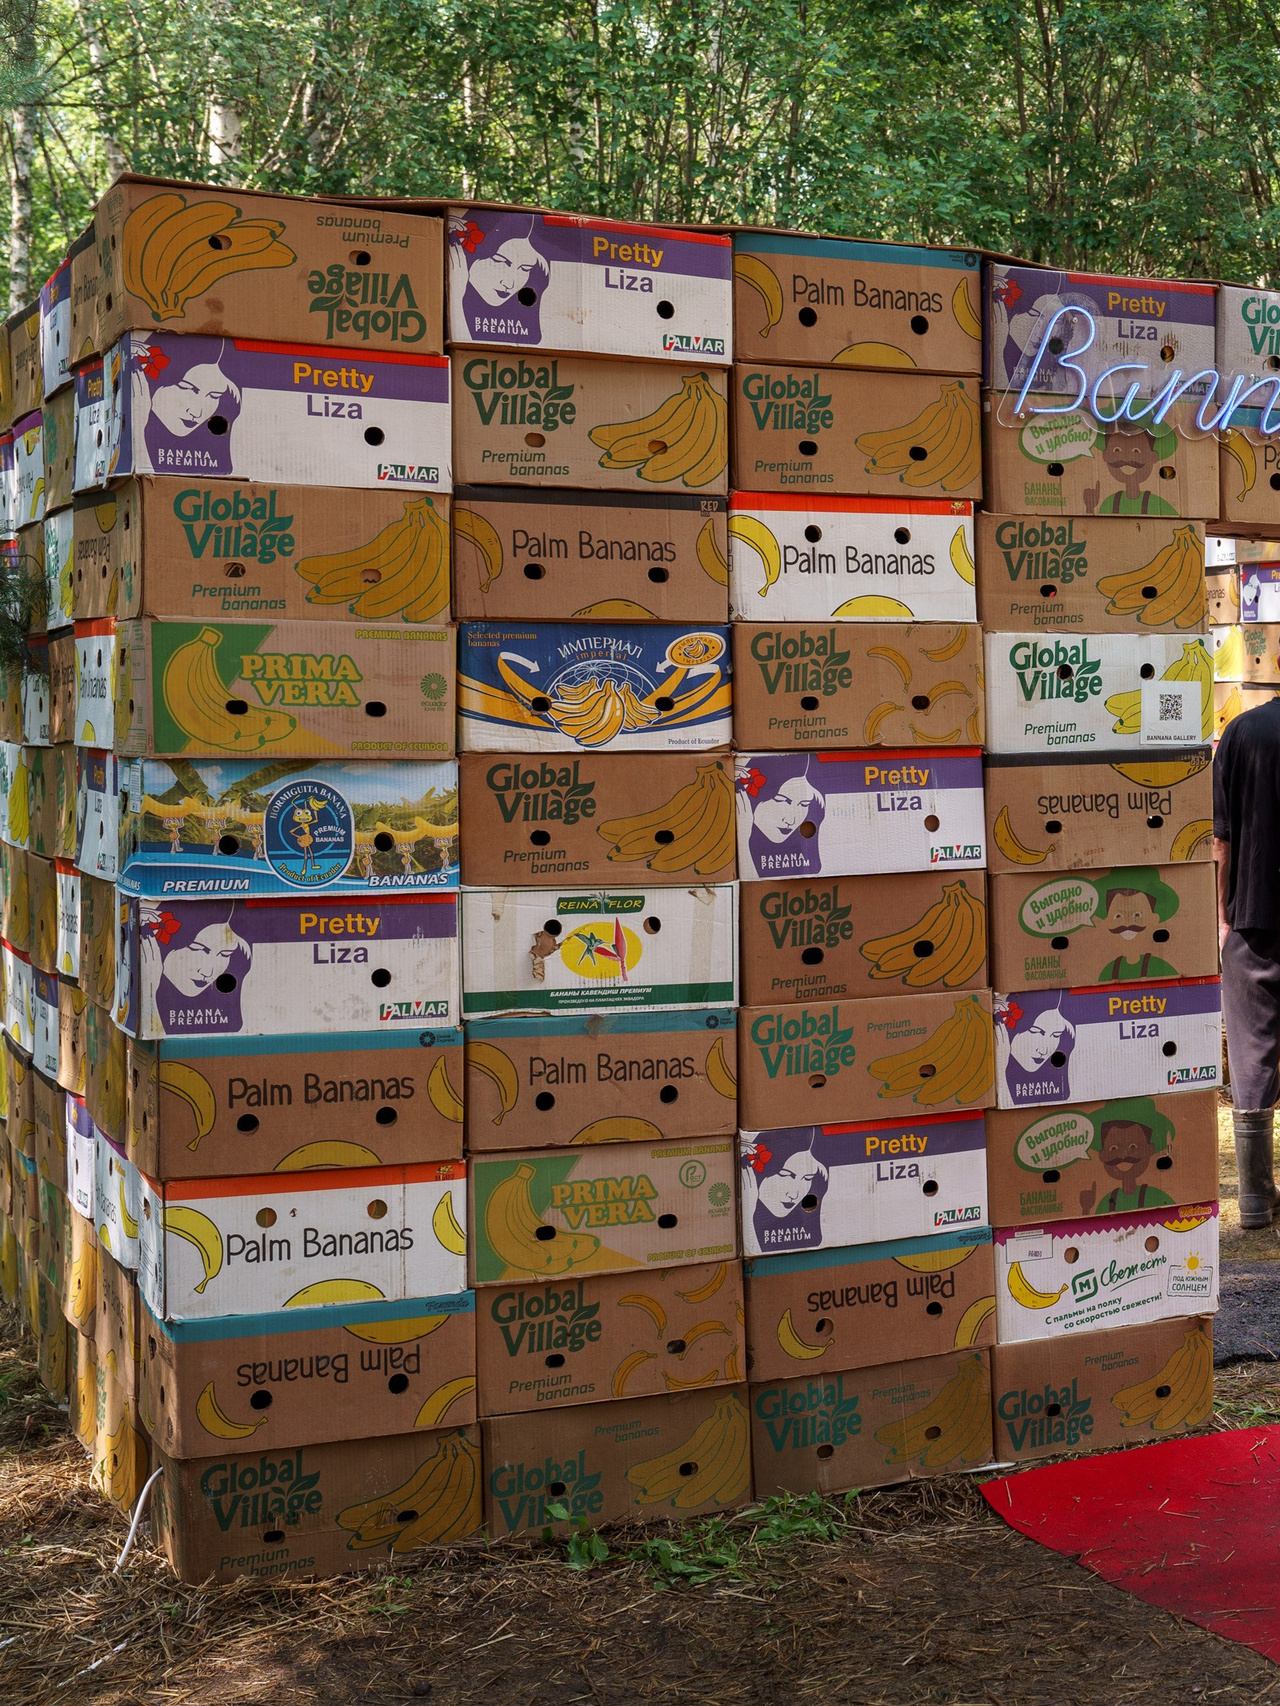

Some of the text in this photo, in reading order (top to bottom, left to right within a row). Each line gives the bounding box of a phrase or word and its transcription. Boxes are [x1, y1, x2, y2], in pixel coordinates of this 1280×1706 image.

[317, 216, 381, 233] bananas
[342, 230, 409, 249] Premium
[593, 237, 663, 268] Pretty
[307, 264, 419, 310] Village
[605, 268, 653, 293] Liza
[1108, 292, 1166, 317] Pretty
[310, 300, 428, 343] Global
[475, 317, 522, 328] BANANA
[475, 325, 529, 336] PREMIUM
[1117, 320, 1158, 341] Liza
[665, 335, 724, 353] PALMAR
[294, 362, 374, 393] Pretty
[463, 359, 575, 392] Global
[307, 395, 363, 420] Liza
[472, 391, 577, 432] Village
[158, 448, 211, 460] BANANA
[158, 456, 218, 467] PREMIUM
[482, 450, 546, 463] Premium
[379, 464, 438, 483] PALMAR
[510, 463, 570, 476] bananas
[173, 489, 294, 530] Global
[700, 501, 719, 512] RED
[182, 523, 295, 564] Village
[783, 545, 935, 576] Palm Bananas
[356, 629, 448, 642] PREMIUM BANANAS
[467, 631, 537, 642] Selected premium
[467, 640, 500, 648] bananas
[557, 636, 643, 659] ИМПЕРИАЛ
[575, 649, 627, 660] imperial
[1009, 638, 1101, 670] Global
[240, 653, 363, 683] PRIMA
[252, 679, 361, 707] VERA
[1016, 671, 1103, 703] Village
[352, 741, 449, 752] PRODUCT OF ECUADOR
[668, 738, 690, 746] Product
[269, 784, 349, 821] HORMIGUITA BANANA
[1038, 790, 1172, 818] Palm Bananas
[314, 826, 346, 837] PREMIUM
[315, 835, 345, 843] BANANAS
[162, 879, 250, 893] PREMIUM
[368, 873, 449, 887] BANANAS
[558, 898, 643, 911] REINA FLOR
[1029, 884, 1082, 915] Выгодно
[1047, 897, 1094, 927] удобно!
[1024, 955, 1061, 969] БАНАНЫ
[550, 989, 580, 998] БАНАНЫ
[620, 986, 652, 995] ПРЕМИУМ
[381, 1000, 449, 1020] PALMAR
[1108, 995, 1167, 1015] Pretty
[751, 1005, 854, 1045] Global
[867, 1019, 911, 1032] Premium
[886, 1025, 927, 1040] bananas
[1119, 1021, 1160, 1040] Liza
[760, 1039, 856, 1079] Village
[1169, 1066, 1216, 1083] PALMAR
[228, 1073, 415, 1109] Palm Bananas
[650, 1143, 732, 1159] PREMIUM BANANAS
[550, 1174, 659, 1209] PRIMA
[562, 1199, 657, 1230] VERA
[226, 1227, 414, 1265] Palm Bananas
[647, 1244, 733, 1263] PRODUCT OF ECUADOR
[1100, 1254, 1168, 1288] Свежесть
[1172, 1275, 1210, 1283] ПОД ЮЖНЫМ
[1171, 1283, 1208, 1292] СОЛНЦЕМ
[1045, 1297, 1123, 1325] С пальмы на полку
[1075, 1306, 1121, 1327] скоростью
[1121, 1291, 1163, 1312] свежести!
[236, 1344, 421, 1387] Palm Bananas
[997, 1377, 1092, 1421] Global
[1005, 1413, 1094, 1452] Village
[200, 1449, 322, 1498] Global
[211, 1485, 323, 1532] Village
